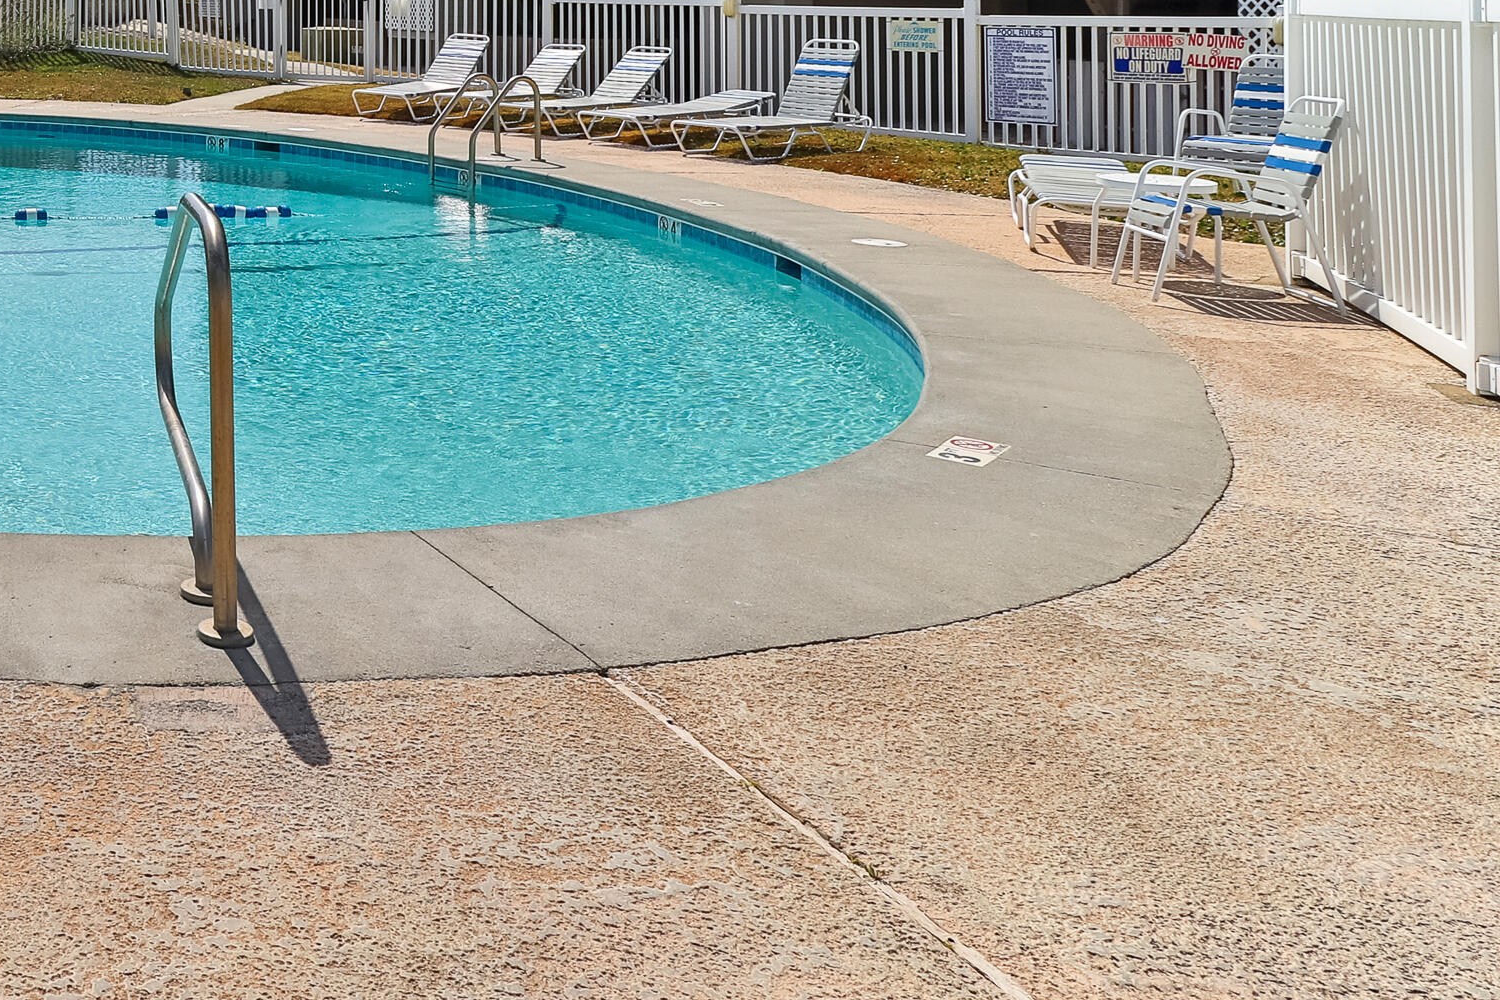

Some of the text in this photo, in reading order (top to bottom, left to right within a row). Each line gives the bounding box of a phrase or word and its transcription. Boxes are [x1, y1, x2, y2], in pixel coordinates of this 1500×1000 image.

[996, 29, 1044, 37] POOL RULES
[921, 41, 936, 49] POOL
[1124, 34, 1173, 47] WARNING
[1188, 33, 1245, 50] NO DIVING
[1116, 47, 1182, 61] NO LIFEGUARD
[1128, 60, 1170, 73] ON DUTY
[1186, 53, 1242, 70] ALLOWED
